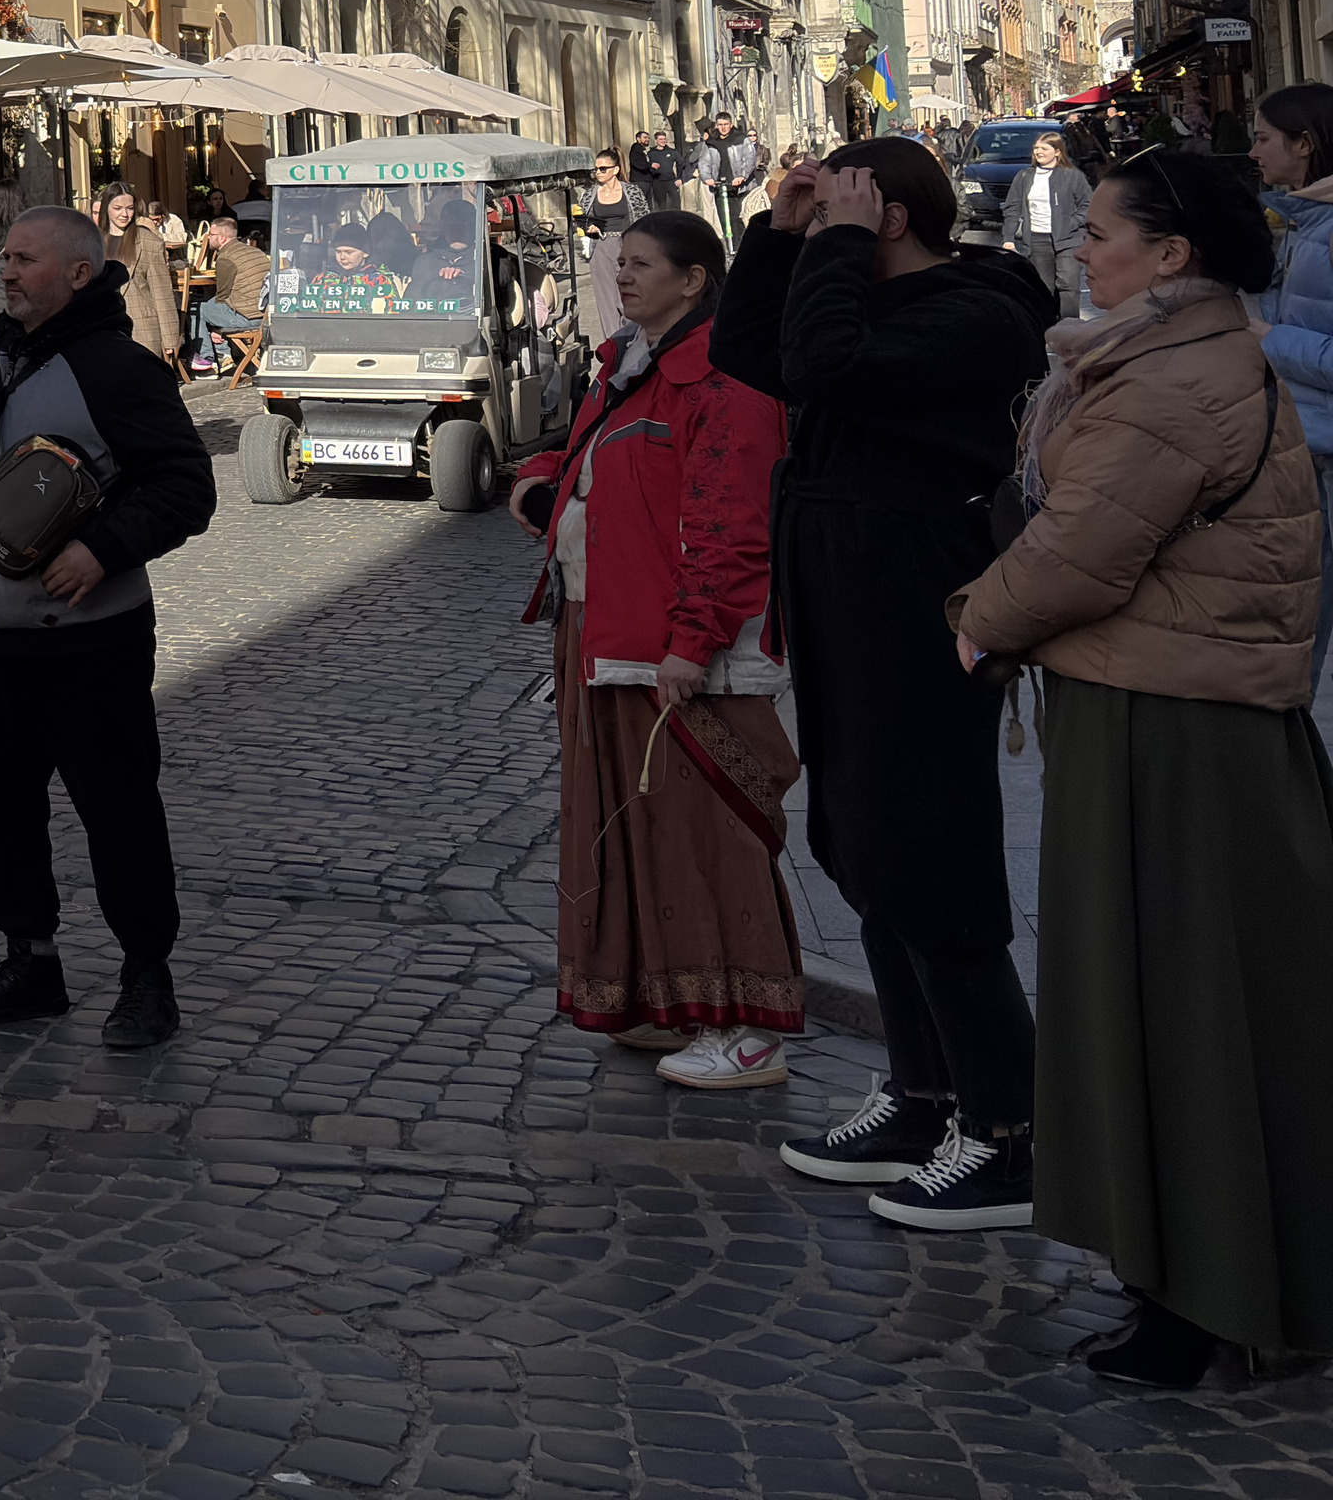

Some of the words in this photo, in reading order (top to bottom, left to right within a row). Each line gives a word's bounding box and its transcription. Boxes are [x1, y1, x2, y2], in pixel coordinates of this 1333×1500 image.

[289, 164, 351, 181] CITY
[374, 161, 465, 180] TOURS
[305, 286, 319, 295] LT
[328, 286, 342, 295] ES
[350, 286, 365, 296] FR
[302, 300, 317, 309] UA
[325, 300, 341, 309] EN
[348, 300, 363, 309] PL
[394, 301, 410, 310] TR
[416, 301, 434, 310] DE
[443, 301, 456, 310] IT
[314, 443, 336, 459] BC
[342, 444, 380, 460] 4666
[384, 445, 402, 461] EI
